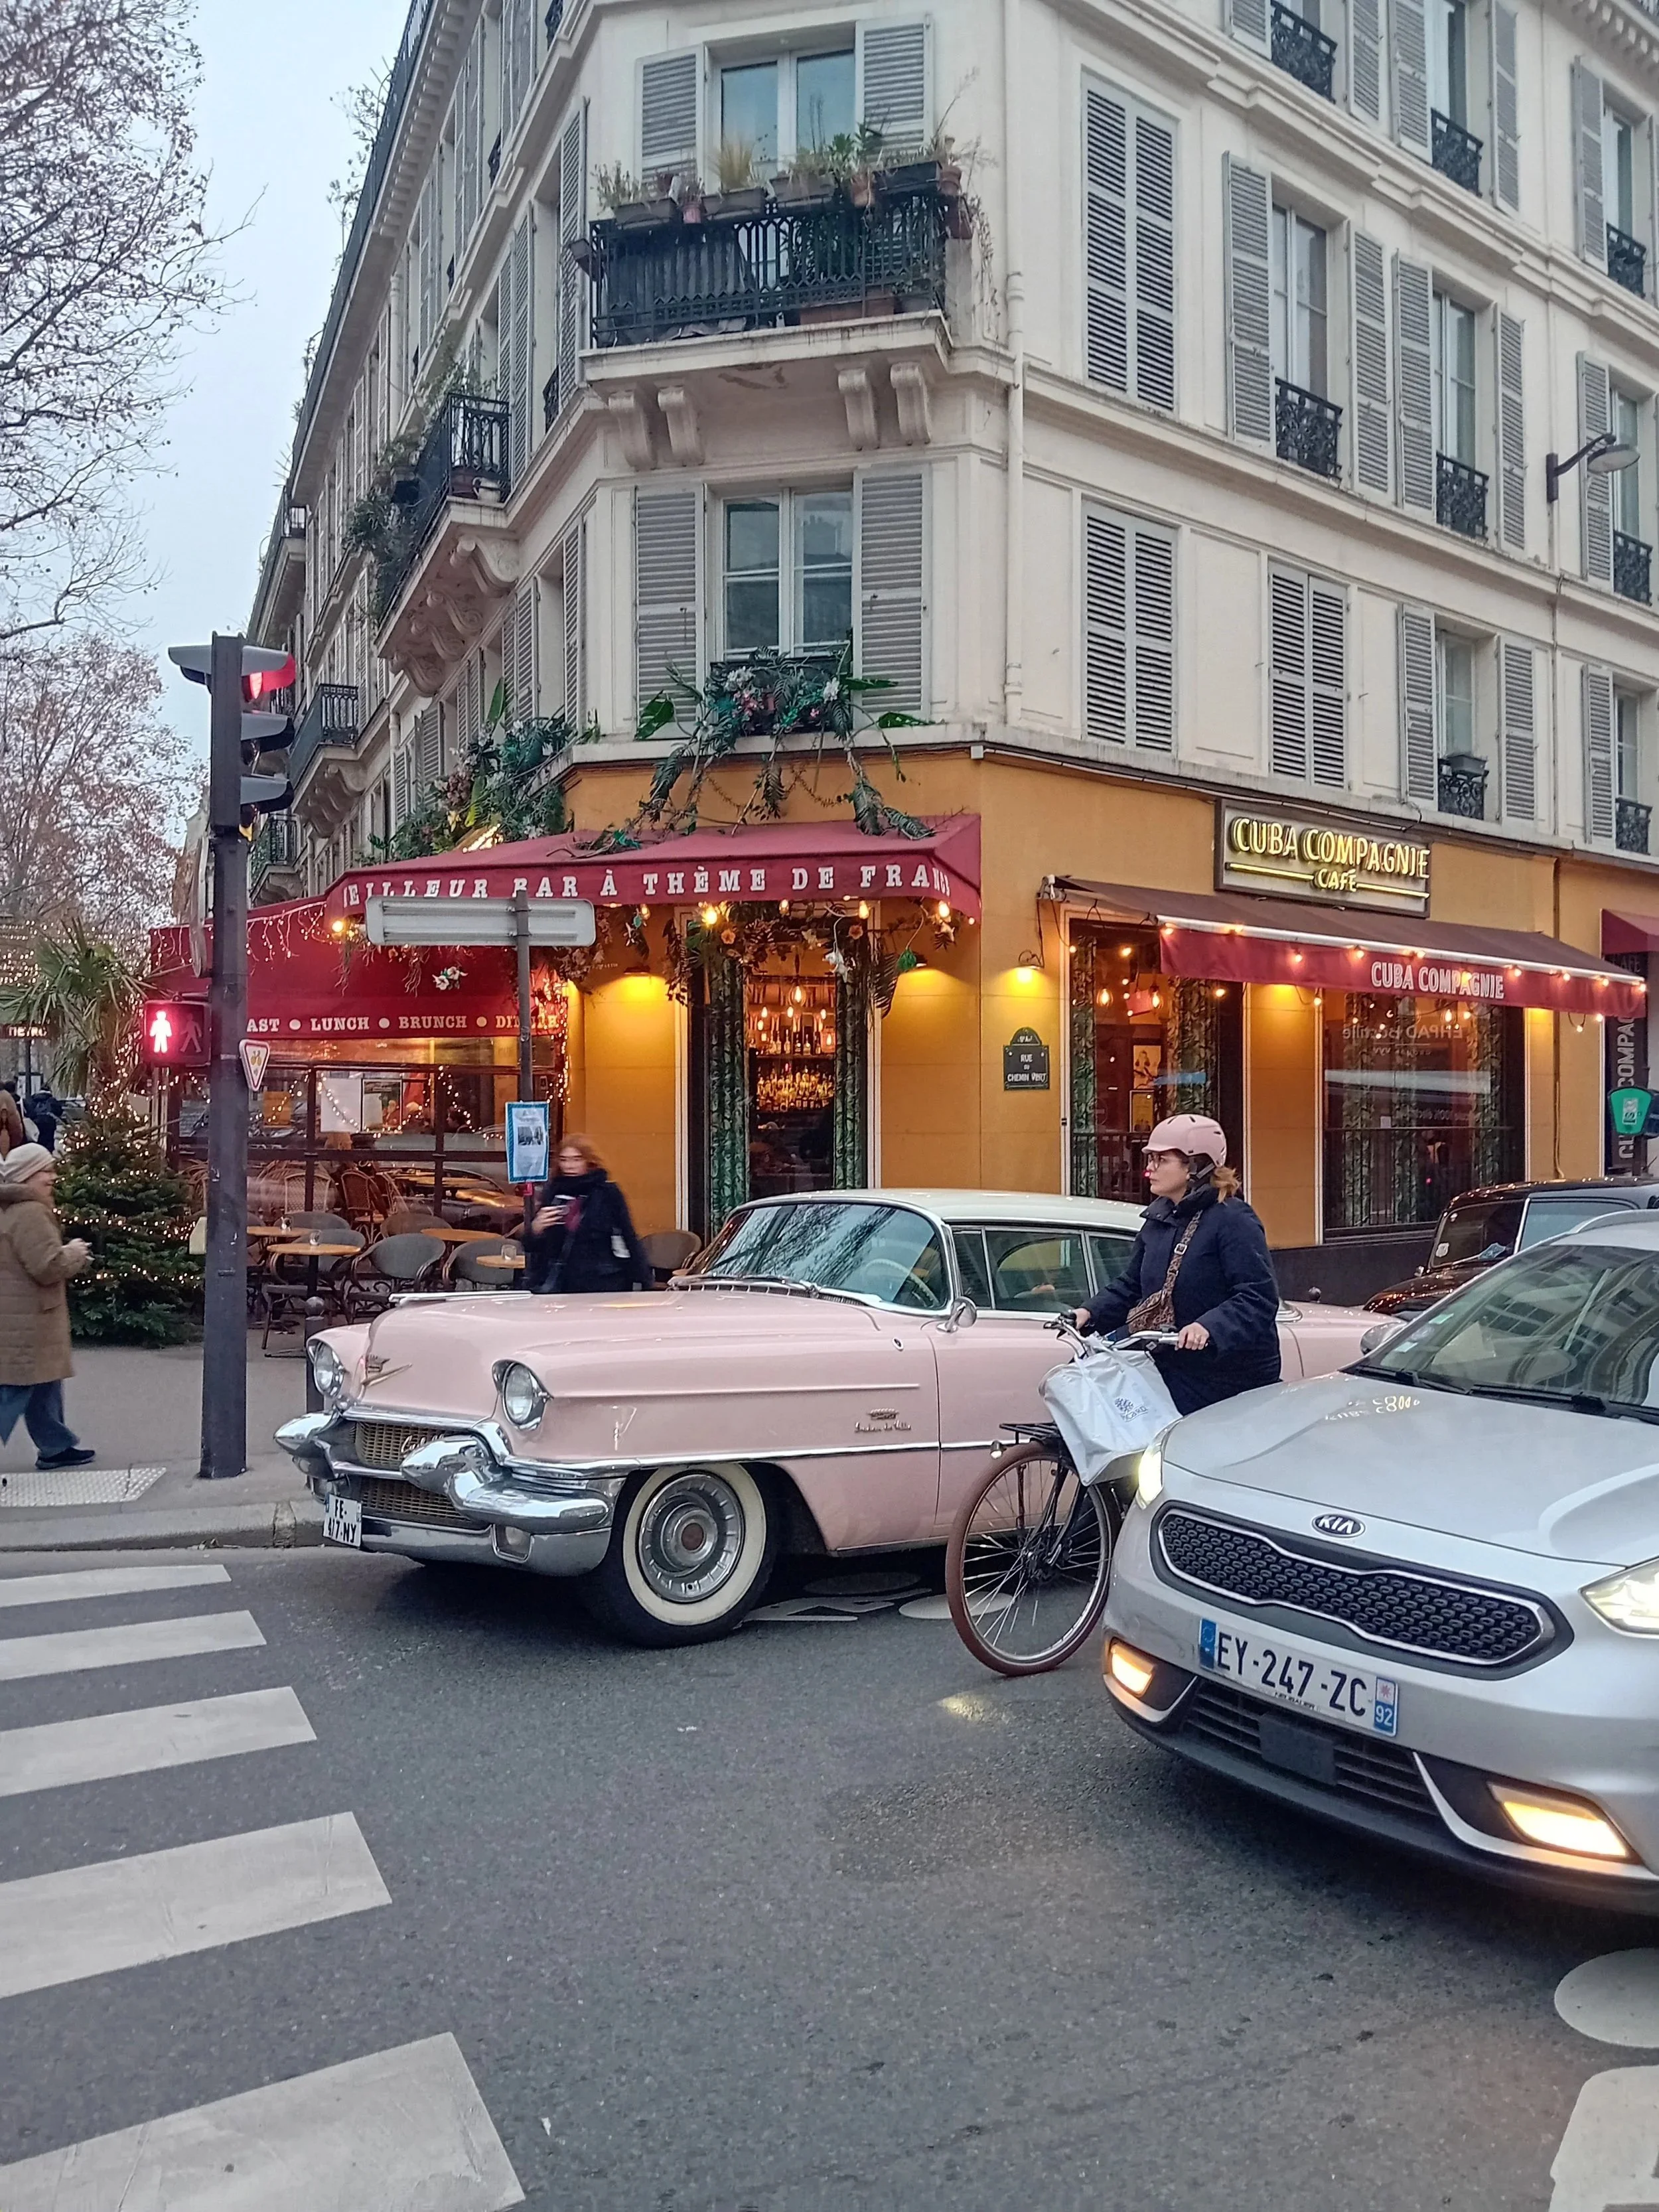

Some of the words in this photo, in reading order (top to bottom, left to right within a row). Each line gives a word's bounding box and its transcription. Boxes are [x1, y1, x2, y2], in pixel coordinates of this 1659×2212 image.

[1231, 817, 1298, 860] CUBA
[1300, 828, 1430, 879] COMPAGNIE
[343, 879, 489, 908] EILLEUR
[512, 875, 579, 898] BAR
[599, 869, 618, 896] À
[642, 865, 766, 895] THÈME
[791, 865, 834, 891] DE
[1370, 961, 1414, 990] CUBA
[1418, 966, 1504, 999] COMPAGNIE
[310, 1016, 370, 1031] LUNCH
[398, 1015, 468, 1029] BRUNCH
[1020, 1053, 1033, 1063] RUE
[1318, 1515, 1354, 1534] KIA
[1217, 1631, 1367, 1717] EY-247-ZC
[1375, 1705, 1393, 1727] 92
